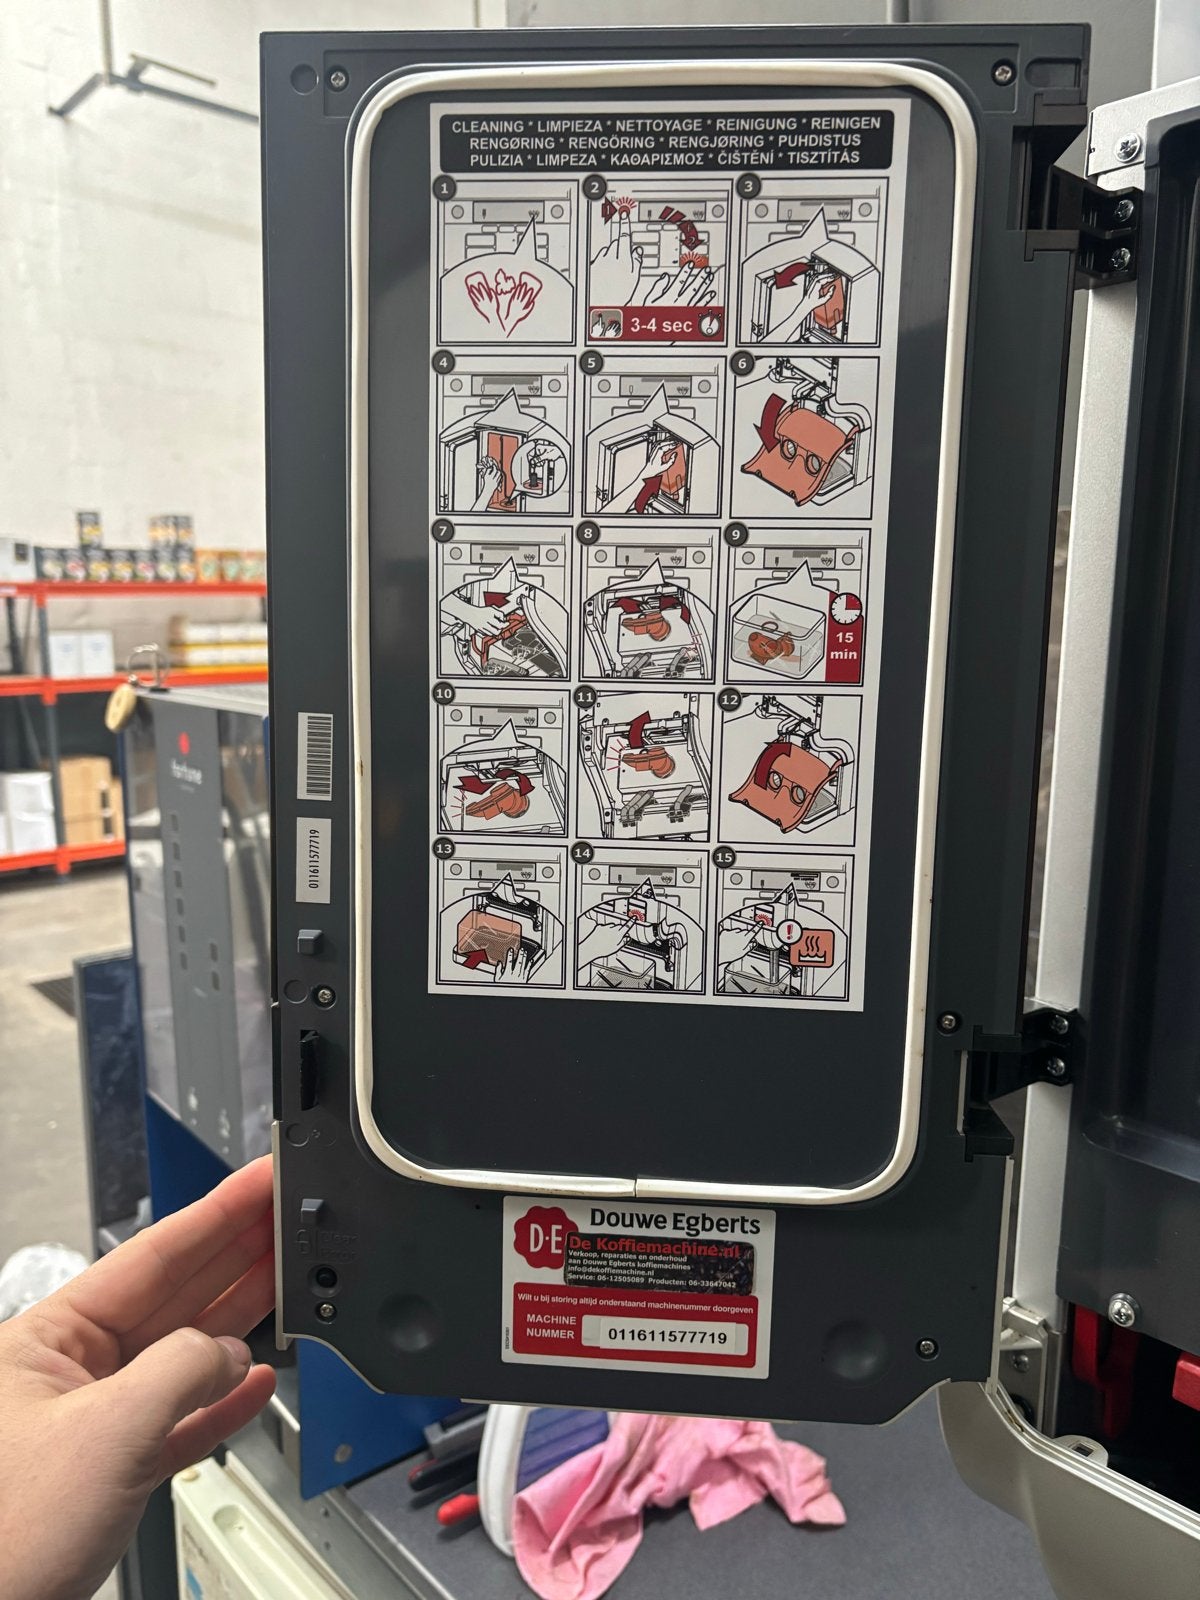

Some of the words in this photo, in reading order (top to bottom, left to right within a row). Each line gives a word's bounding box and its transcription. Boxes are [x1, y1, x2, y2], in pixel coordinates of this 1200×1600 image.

[452, 120, 524, 133] CLEANING
[537, 120, 603, 133] LIMPIEZA
[615, 119, 703, 132] NETTOYAGE
[716, 118, 797, 131] REINIGUNG
[811, 117, 881, 130] REINIGEN
[470, 137, 555, 149] RENGØRING
[569, 134, 654, 149] RENGÖRING
[669, 135, 764, 148] RENGJØRING
[778, 134, 861, 147] PUHDISTUS
[470, 154, 523, 166] PULIZIA
[536, 154, 597, 166] LIMPEZA
[718, 150, 774, 165] ČIŠTĚNÍ
[788, 149, 860, 164] TISZTÍTÁS
[441, 182, 449, 194] 1
[590, 181, 600, 194] 2
[744, 180, 753, 193] 3
[630, 317, 657, 332] 3-4
[662, 320, 693, 333] sec
[439, 356, 448, 368] 4
[587, 357, 596, 369] 5
[738, 357, 747, 369] 6
[438, 525, 448, 537] 7
[583, 527, 593, 539] 8
[731, 529, 741, 541] 9
[836, 631, 854, 643] 15
[830, 648, 858, 660] min
[436, 688, 452, 699] 10
[577, 691, 594, 703] 11
[721, 694, 739, 705] 12
[436, 843, 452, 854] 13
[574, 848, 591, 858] 14
[308, 828, 320, 889] 011611577719
[716, 852, 733, 863] 15
[590, 1208, 667, 1230] Douwe
[672, 1212, 760, 1237] Egberts
[569, 1236, 591, 1250] De
[597, 1238, 740, 1259] Koffiemachine.nl
[568, 1249, 599, 1259] Verkoop,
[601, 1251, 637, 1261] reparaties
[649, 1254, 687, 1262] onderhoud
[583, 1258, 607, 1266] Douwe
[609, 1259, 636, 1269] Egberts
[637, 1261, 691, 1270] koffiemachines
[568, 1265, 655, 1276] info@dekoffiemachine.nl
[567, 1272, 596, 1281] Service:
[648, 1277, 687, 1286] Producten:
[517, 1293, 532, 1301] Wilt
[540, 1294, 550, 1304] bij
[551, 1295, 578, 1305] storing
[579, 1297, 598, 1307] altijd
[599, 1298, 646, 1308] onderstaand
[647, 1301, 711, 1311] machinenummer
[712, 1305, 754, 1315] doorgeven
[526, 1313, 577, 1325] MACHINE
[526, 1327, 575, 1340] NUMMER
[608, 1327, 727, 1345] 011611577719
